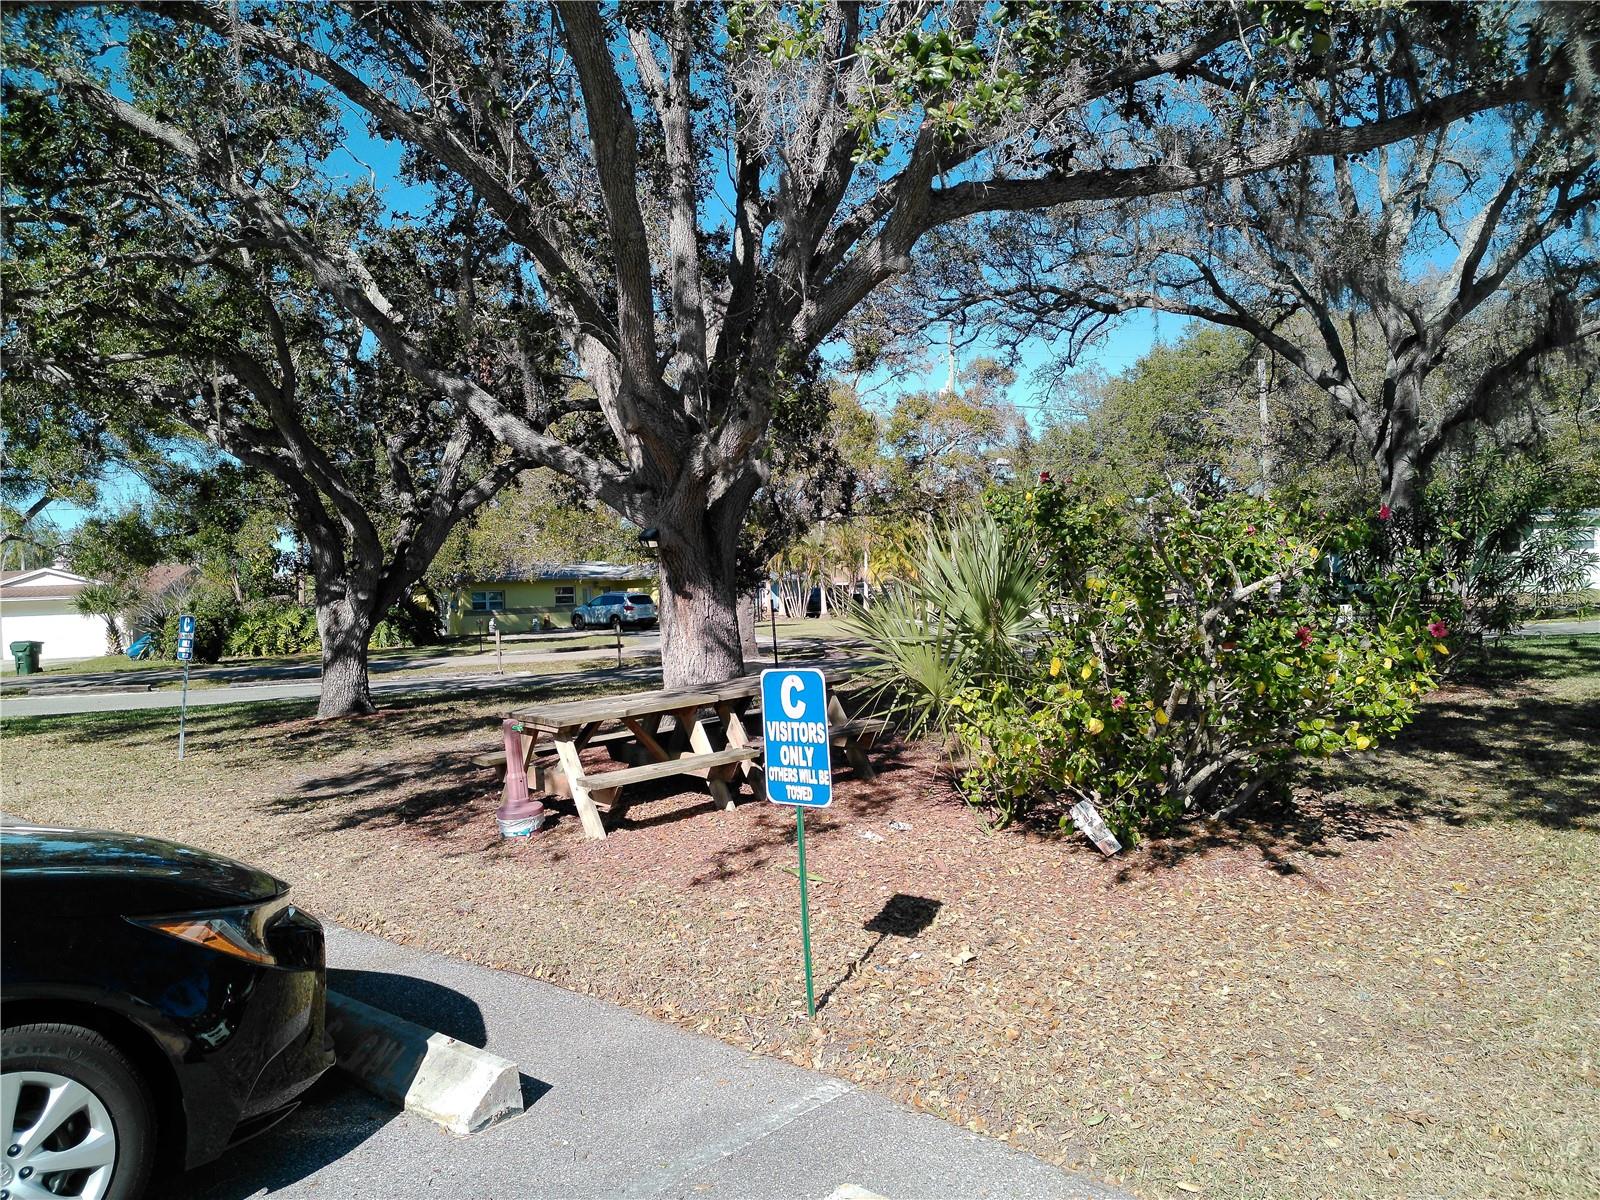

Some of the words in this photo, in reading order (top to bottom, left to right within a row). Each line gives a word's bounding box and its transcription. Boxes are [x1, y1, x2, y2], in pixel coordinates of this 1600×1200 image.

[184, 617, 191, 632] C
[780, 674, 807, 720] C
[766, 720, 826, 744] VISITORS
[780, 745, 815, 767] ONLY
[768, 766, 799, 783] OTHERS
[798, 768, 818, 785] WILL
[818, 769, 830, 786] BE
[785, 785, 813, 802] TOWED
